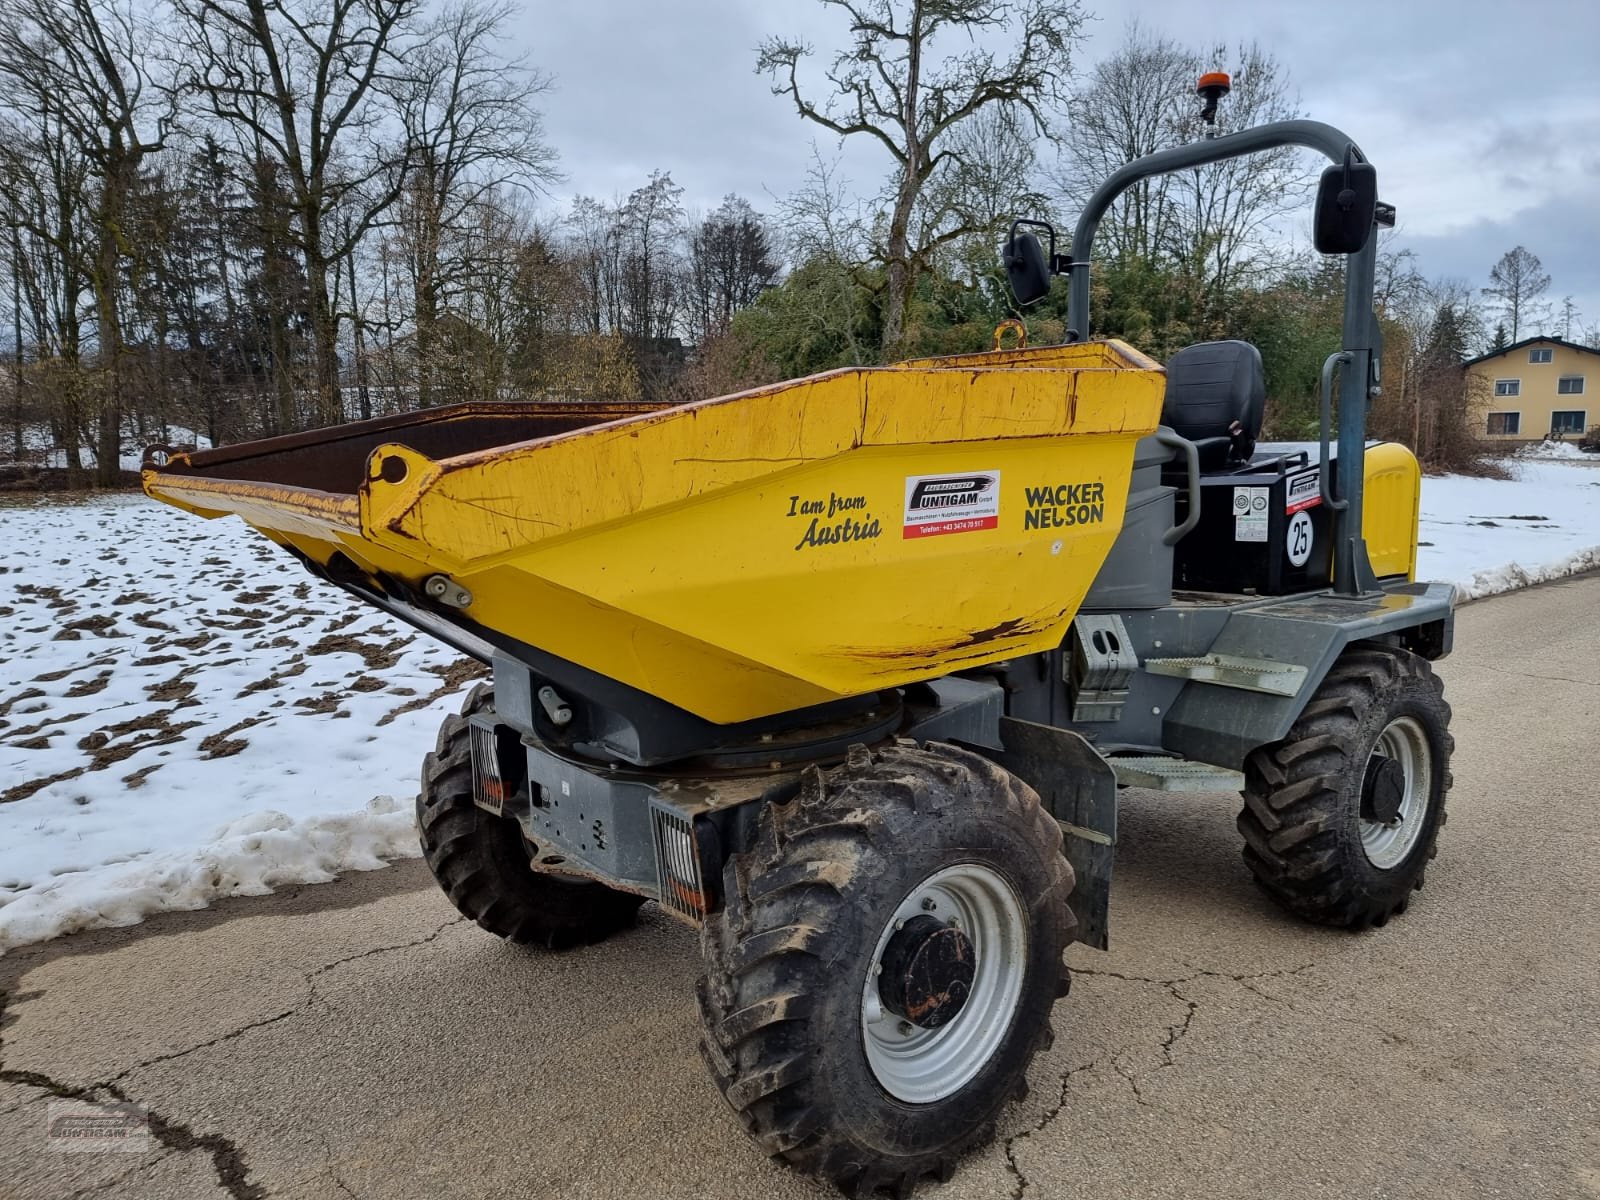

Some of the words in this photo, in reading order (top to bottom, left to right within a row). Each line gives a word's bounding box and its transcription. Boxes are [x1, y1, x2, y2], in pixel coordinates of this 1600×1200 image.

[786, 495, 799, 516] I
[800, 500, 825, 515] am
[827, 492, 866, 518] from
[1025, 483, 1104, 508] WACKER
[920, 525, 942, 534] Telefon:
[943, 523, 953, 531] +43
[1025, 503, 1104, 530] NELSON
[795, 513, 882, 551] Austria
[1293, 520, 1308, 556] 25
